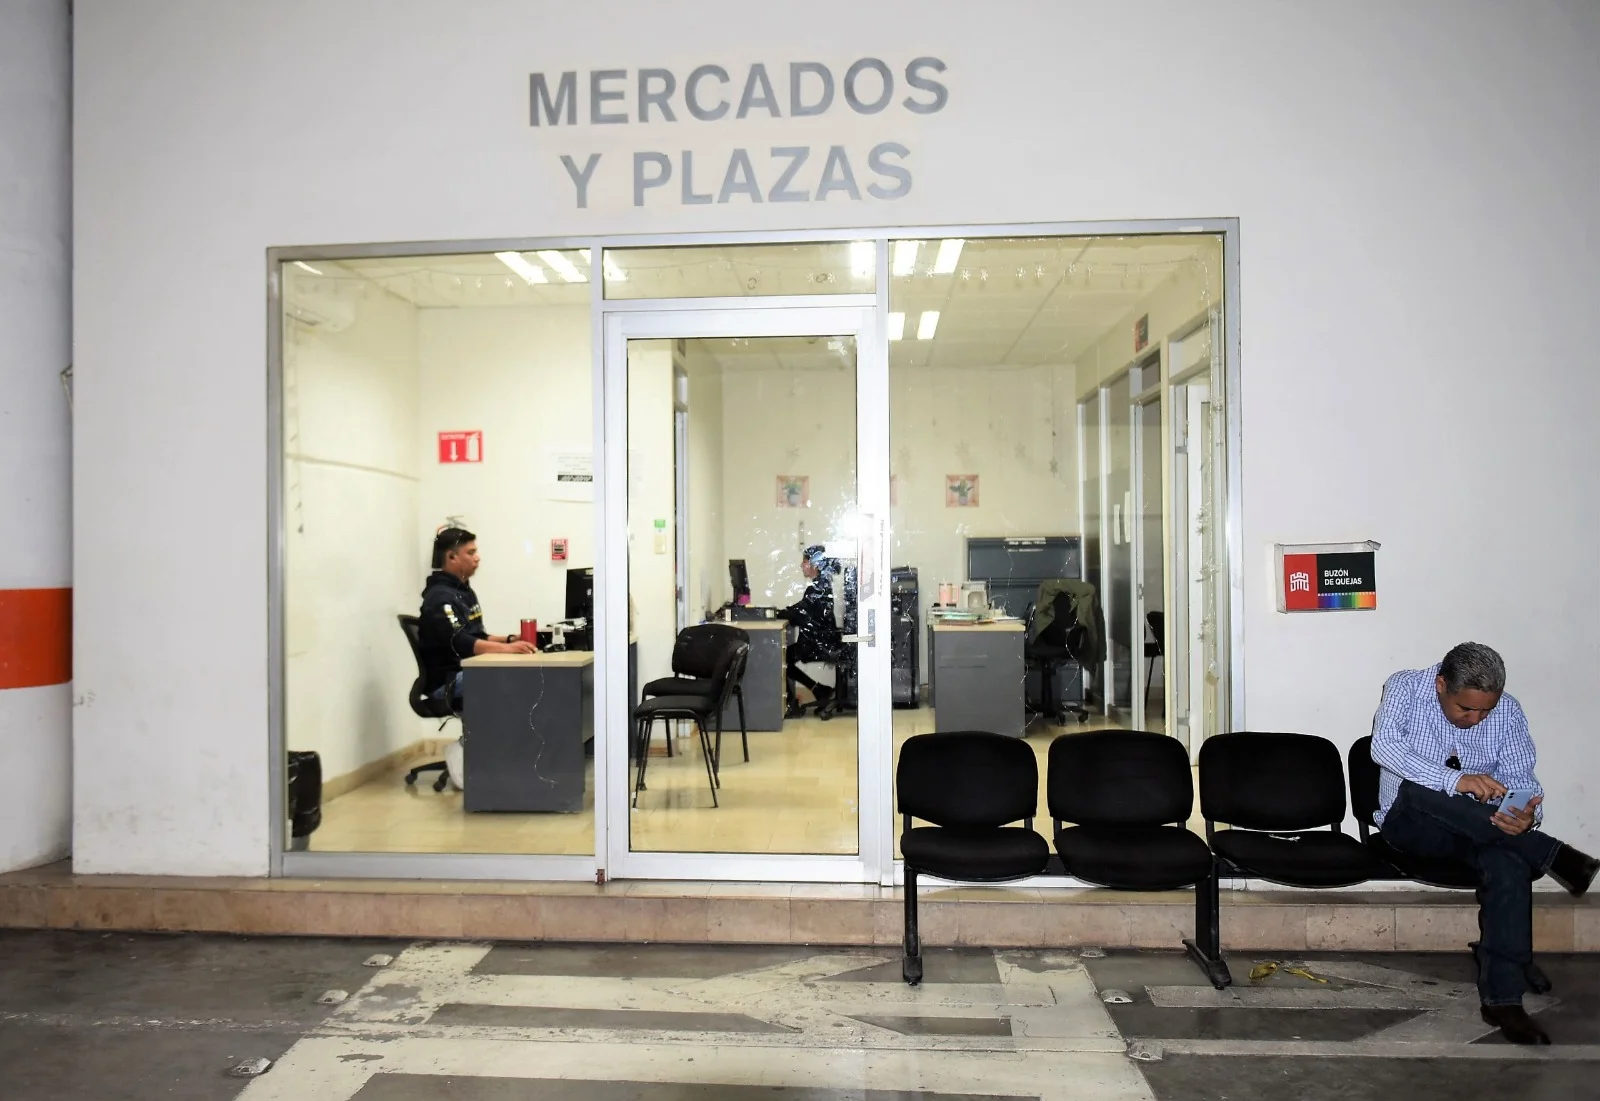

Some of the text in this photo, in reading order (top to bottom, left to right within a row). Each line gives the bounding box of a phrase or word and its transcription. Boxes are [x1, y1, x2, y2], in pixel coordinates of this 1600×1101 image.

[528, 56, 949, 128] MERCADOS
[559, 142, 913, 209] Y PLAZAS
[1324, 567, 1349, 578] BUZÓN
[1324, 577, 1363, 586] DE QUEJAS
